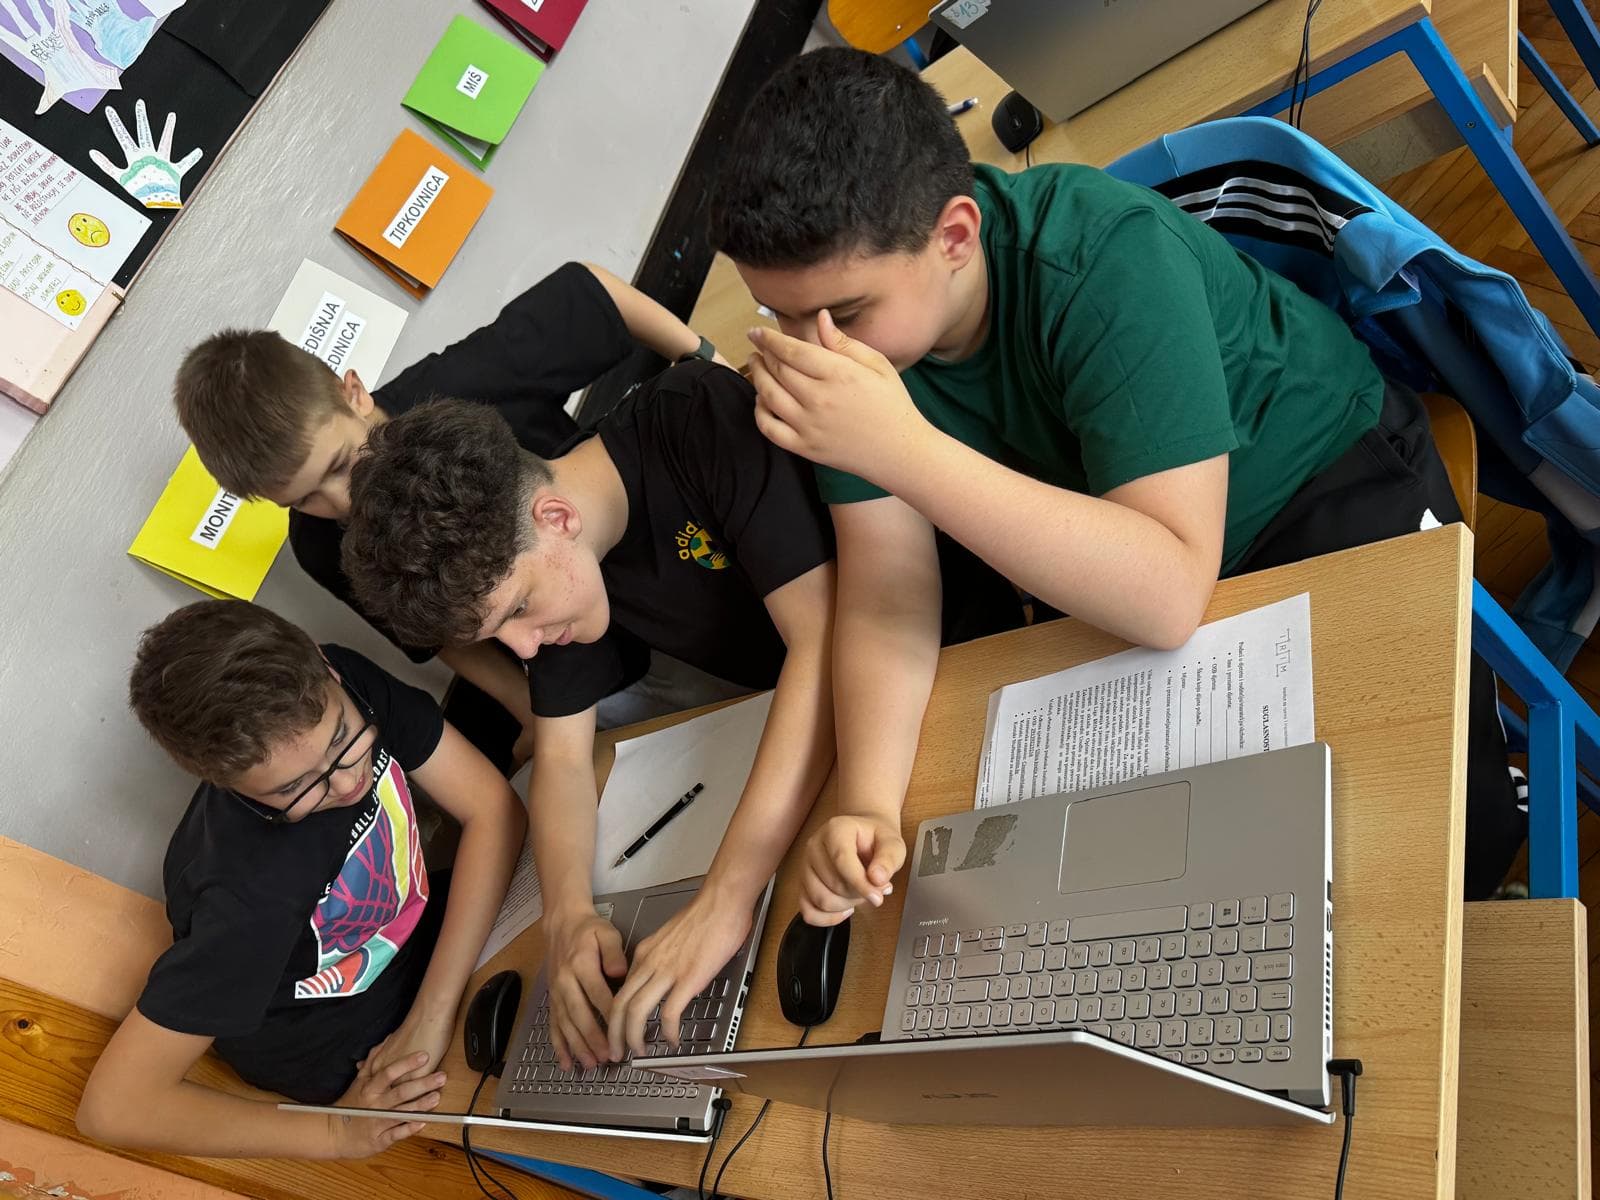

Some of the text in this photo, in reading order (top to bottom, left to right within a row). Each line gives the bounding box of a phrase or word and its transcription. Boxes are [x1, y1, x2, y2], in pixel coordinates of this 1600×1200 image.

[460, 69, 482, 93] MIŠ
[389, 175, 444, 241] TIPKOVNICA
[199, 490, 237, 540] MONIT
